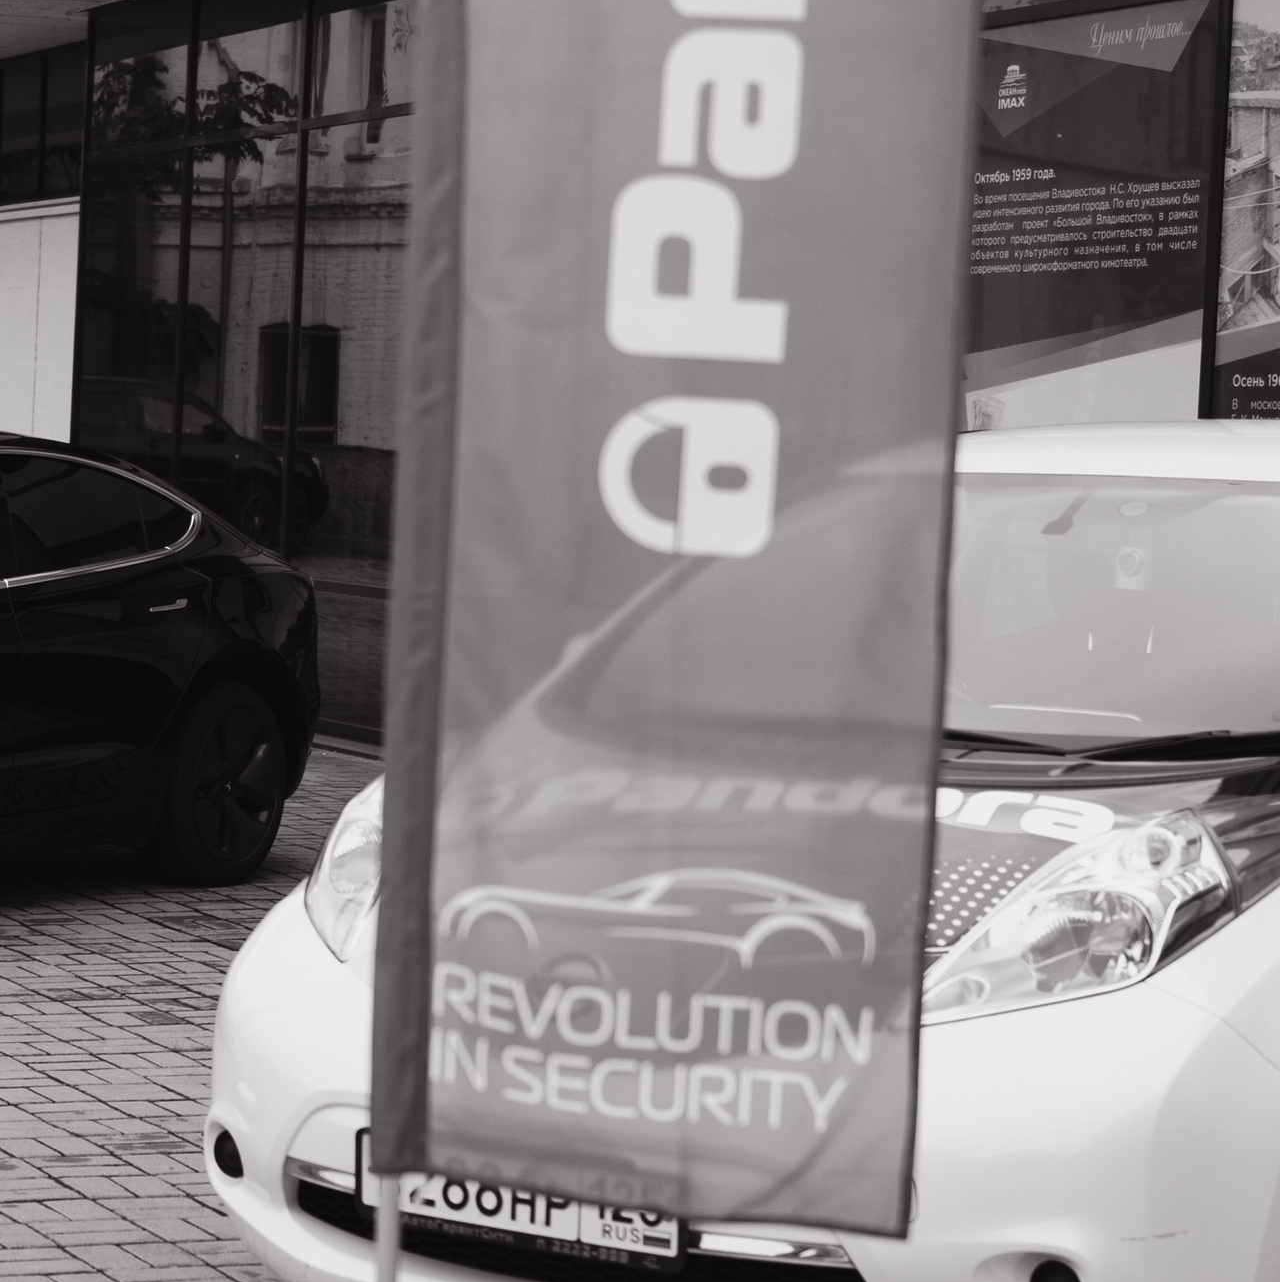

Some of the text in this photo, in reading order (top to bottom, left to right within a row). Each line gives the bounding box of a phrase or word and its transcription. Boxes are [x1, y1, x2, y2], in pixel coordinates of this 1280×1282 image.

[1089, 19, 1133, 57] Ценим
[998, 96, 1026, 110] IMAX
[974, 168, 1056, 184] Октябрь 1959 года.
[973, 179, 1200, 205] Во время посещения Владивостока Н.С. Хрущев высказал
[972, 192, 1200, 219] идею интенсивного развития города. По его указанию был
[971, 210, 1199, 234] разработан проект «Большой Владивосток», в рамках
[971, 225, 1198, 247] которого предусматривалось строительство двадцати
[970, 240, 1198, 260] объектов культурного назначения, в том числе
[969, 257, 1149, 275] современного широкоформатного кинотеатра.
[1232, 373, 1280, 387] Осень 19
[1231, 398, 1239, 410] В
[430, 959, 875, 1067] REVOLUTION
[427, 1025, 852, 1135] IN SECURITY
[601, 1222, 642, 1245] RUS
